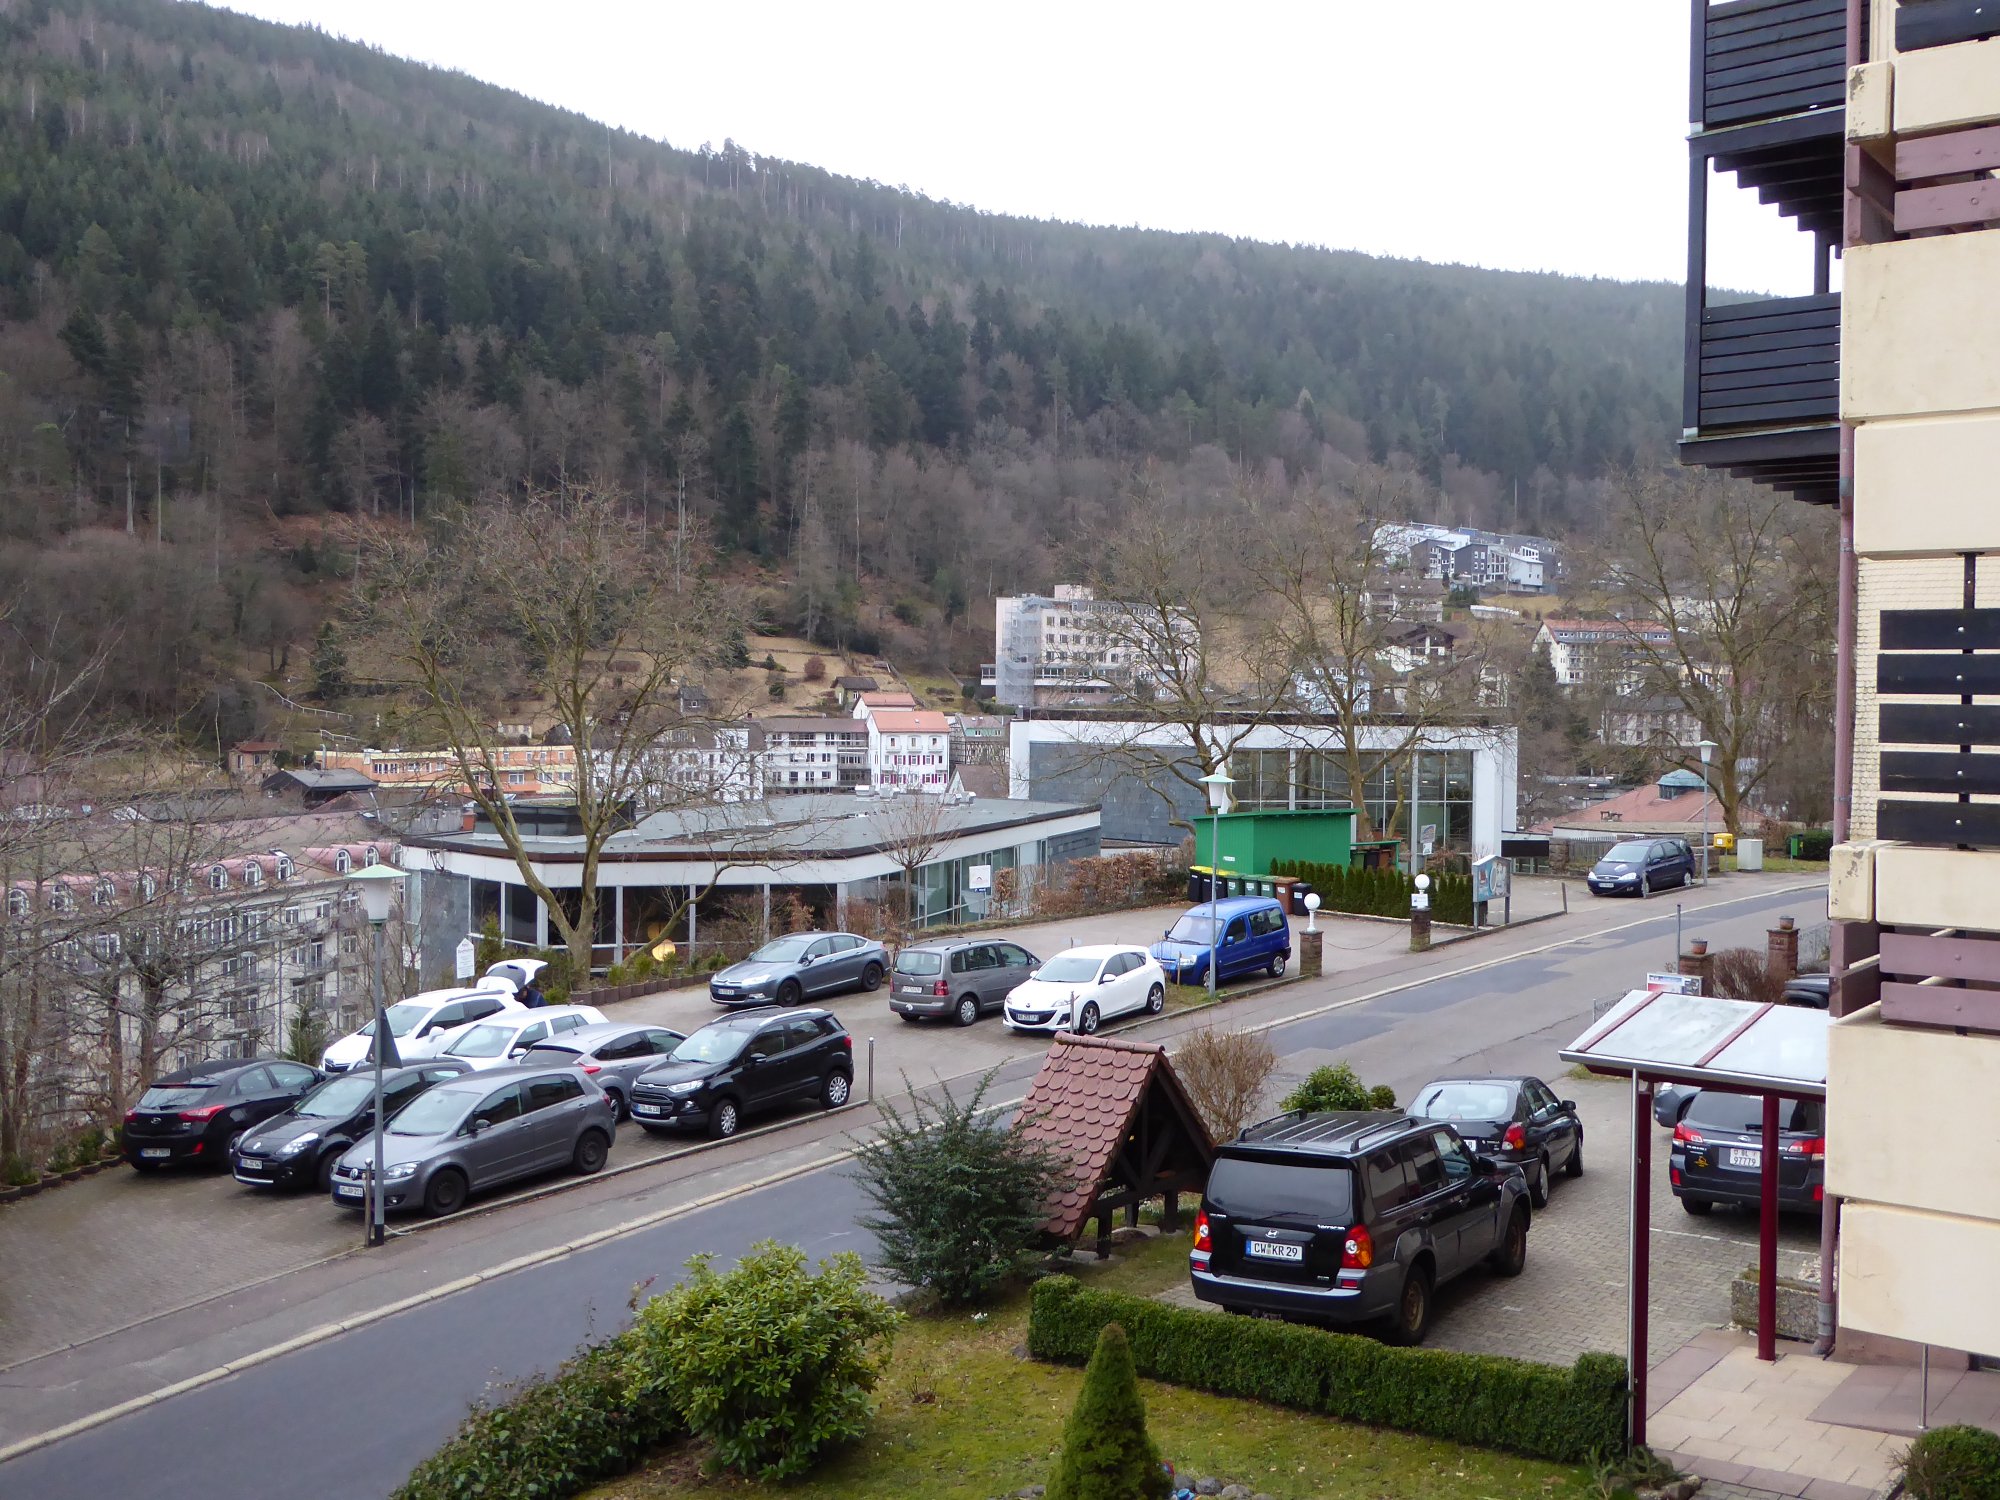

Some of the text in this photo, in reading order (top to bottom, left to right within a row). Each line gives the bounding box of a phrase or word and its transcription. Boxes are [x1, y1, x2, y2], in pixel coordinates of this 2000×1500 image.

[1733, 1157, 1756, 1165] 97779
[1254, 1243, 1298, 1257] CW KR 29
